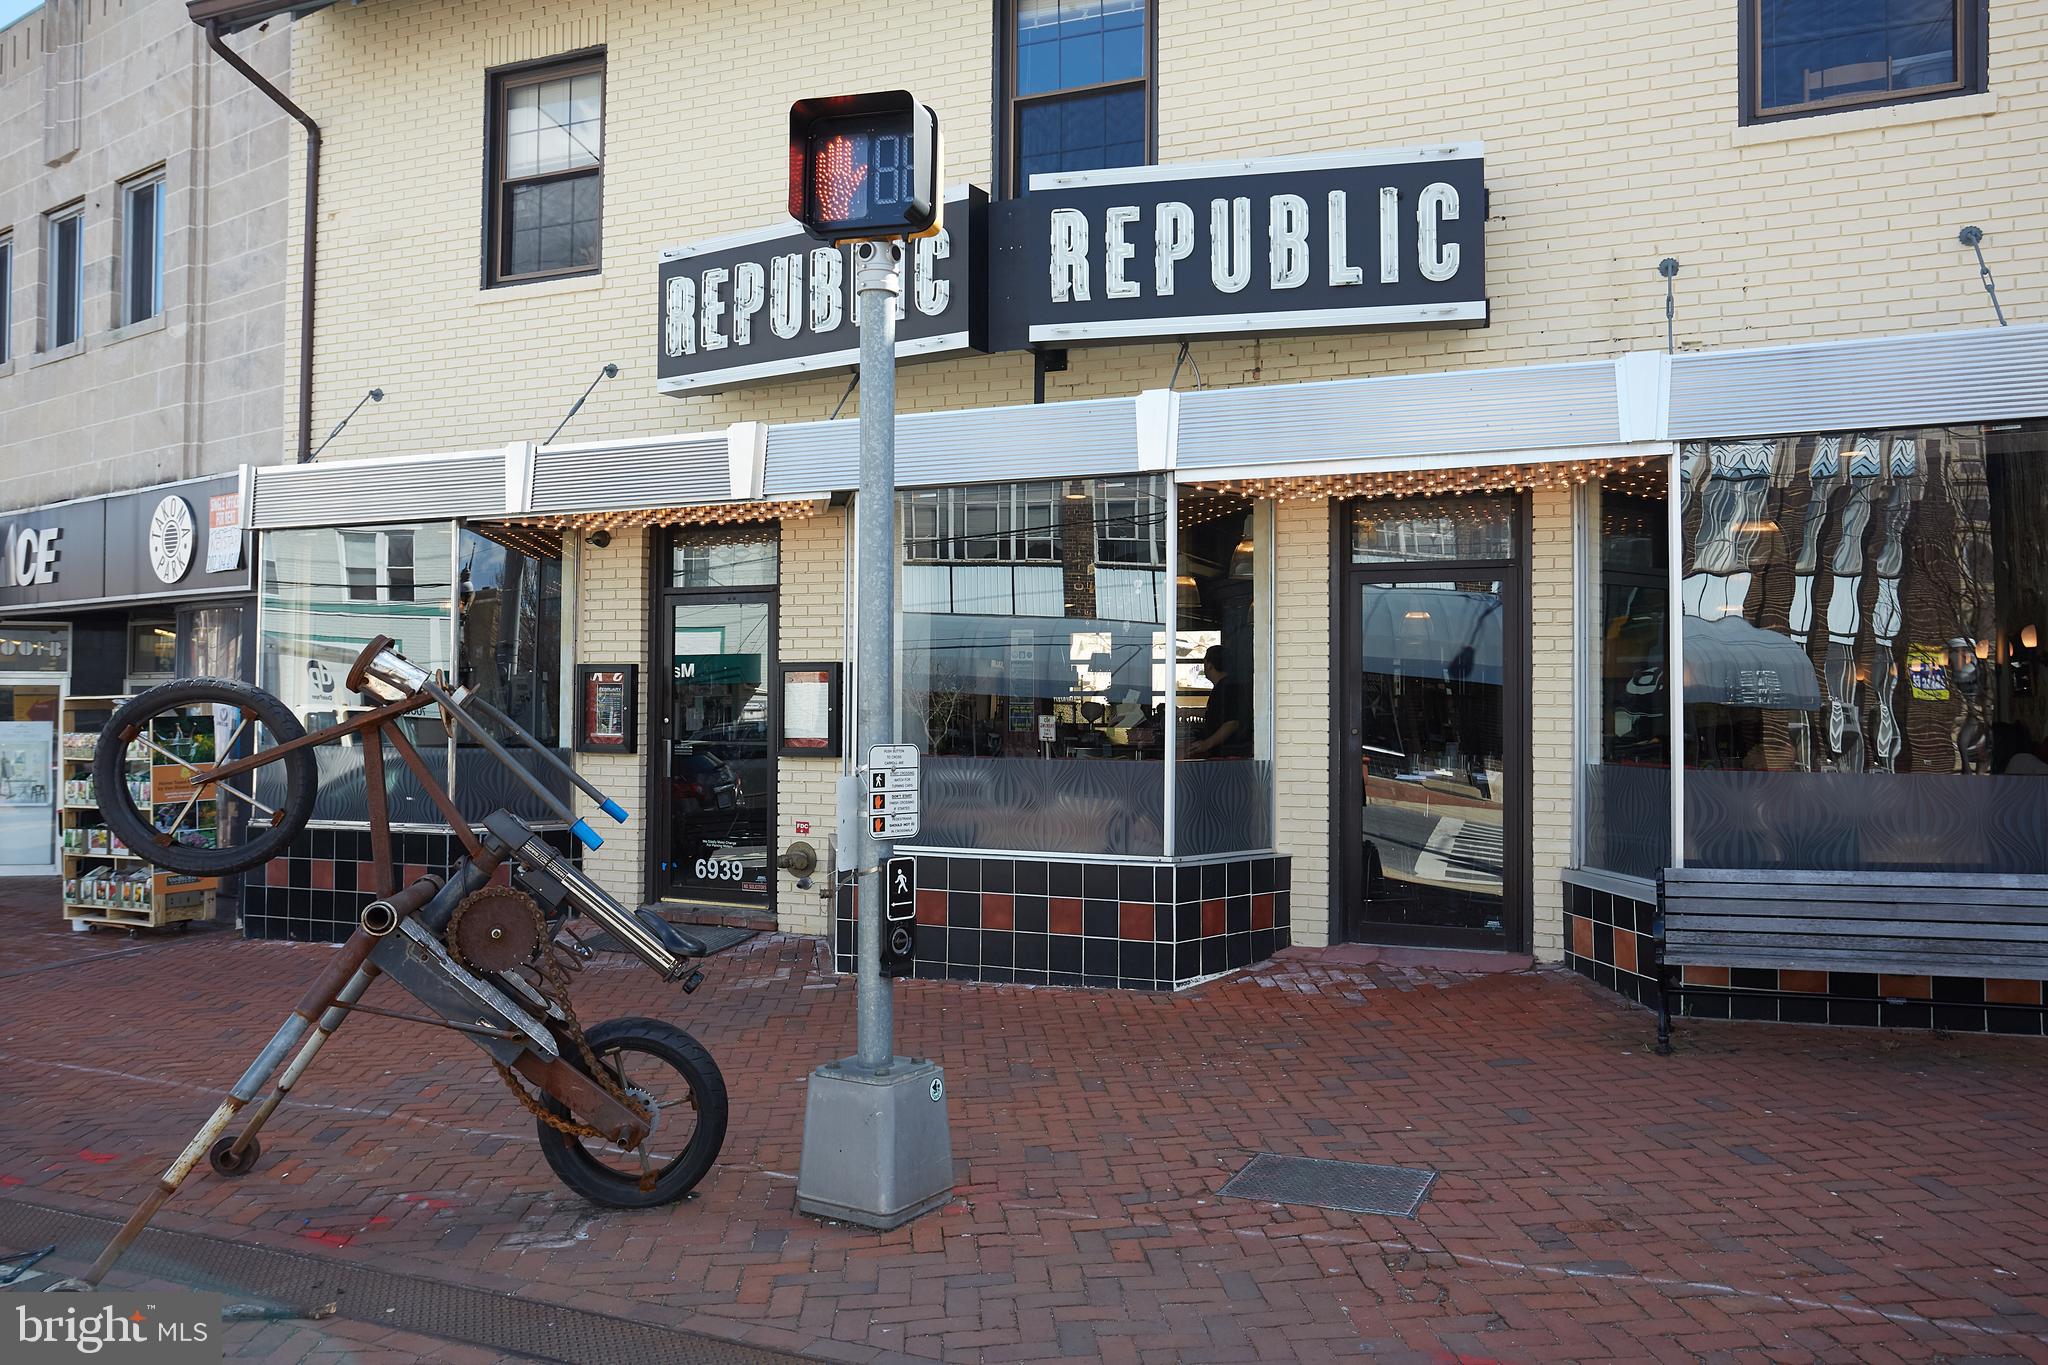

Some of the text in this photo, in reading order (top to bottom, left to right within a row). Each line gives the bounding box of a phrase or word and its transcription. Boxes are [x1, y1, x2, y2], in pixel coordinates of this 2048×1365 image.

[1049, 182, 1460, 303] REPUBLIC
[152, 498, 191, 539] TAKOMA
[157, 555, 185, 580] PARK
[695, 858, 743, 881] 6939
